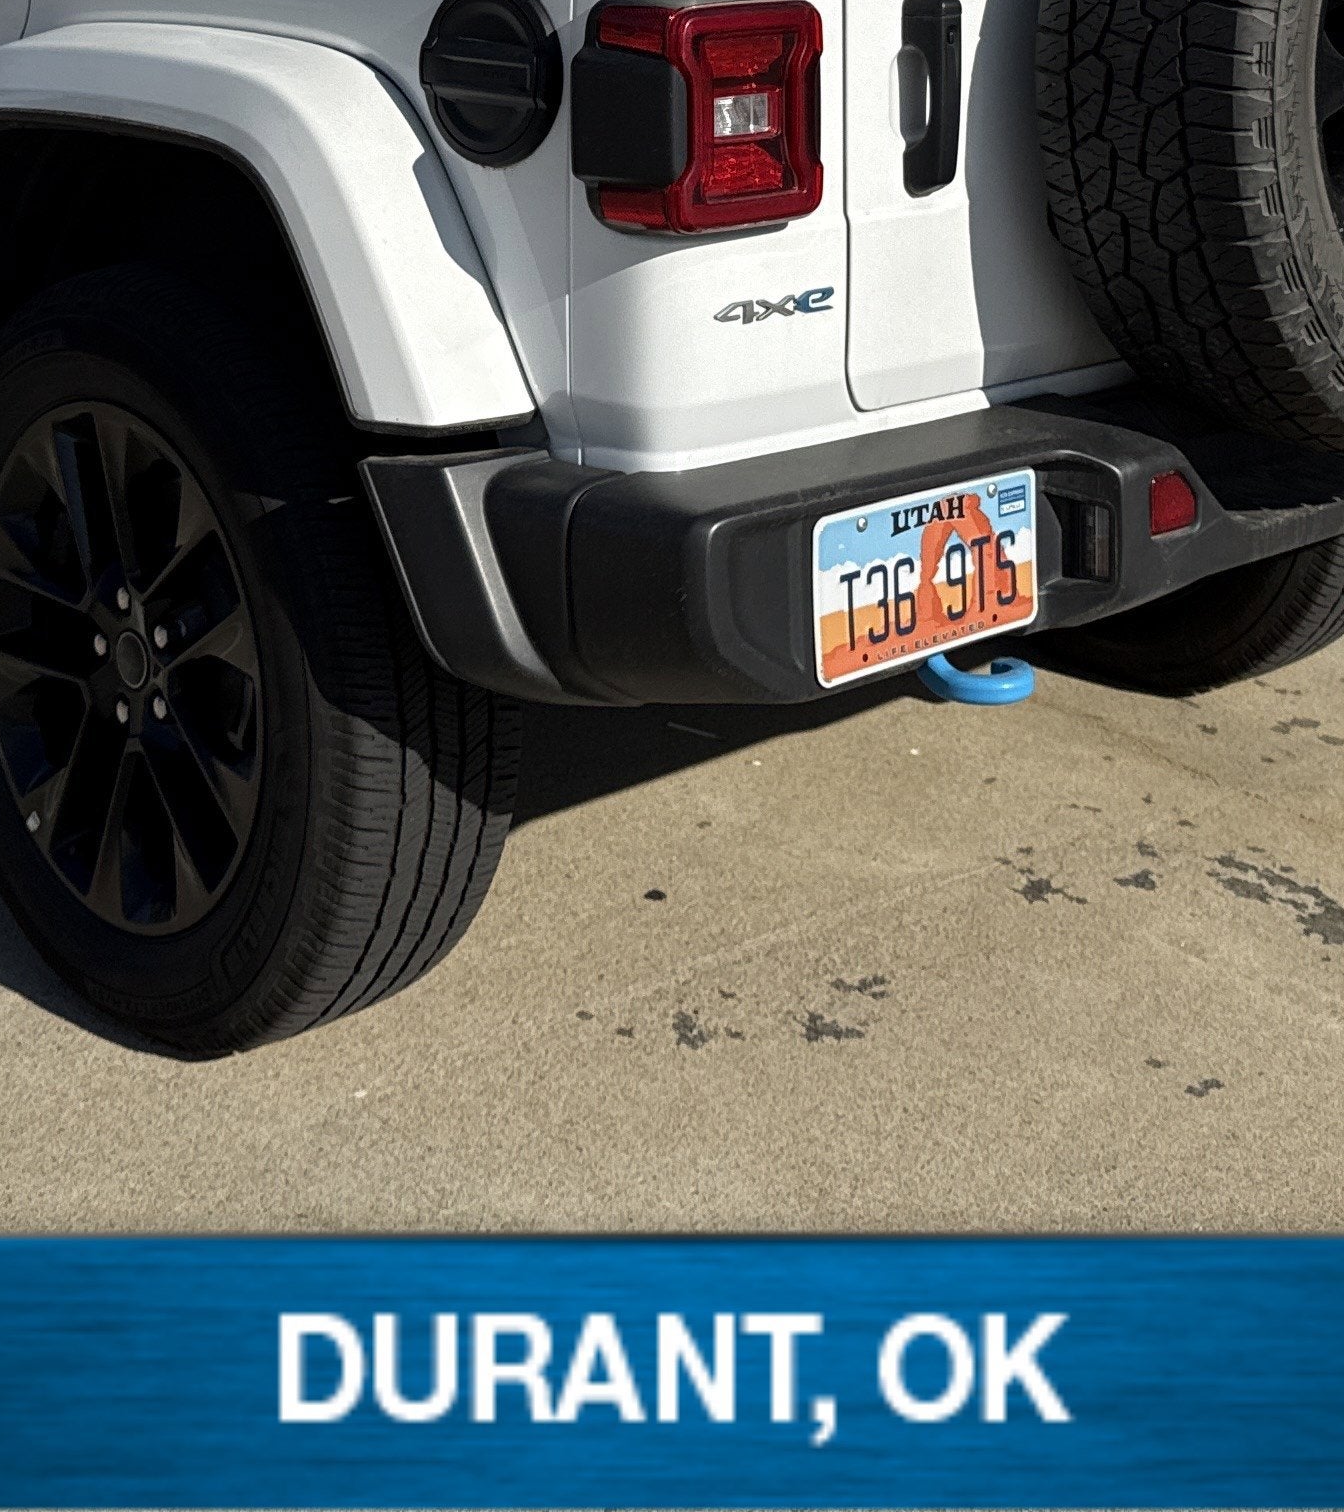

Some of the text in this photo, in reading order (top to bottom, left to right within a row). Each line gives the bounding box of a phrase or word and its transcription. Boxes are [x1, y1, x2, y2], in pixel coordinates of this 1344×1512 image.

[713, 286, 834, 325] 4xe
[890, 494, 965, 538] UTAH
[839, 528, 1018, 652] T36 9TS
[876, 620, 986, 661] LIFE ELEVATED
